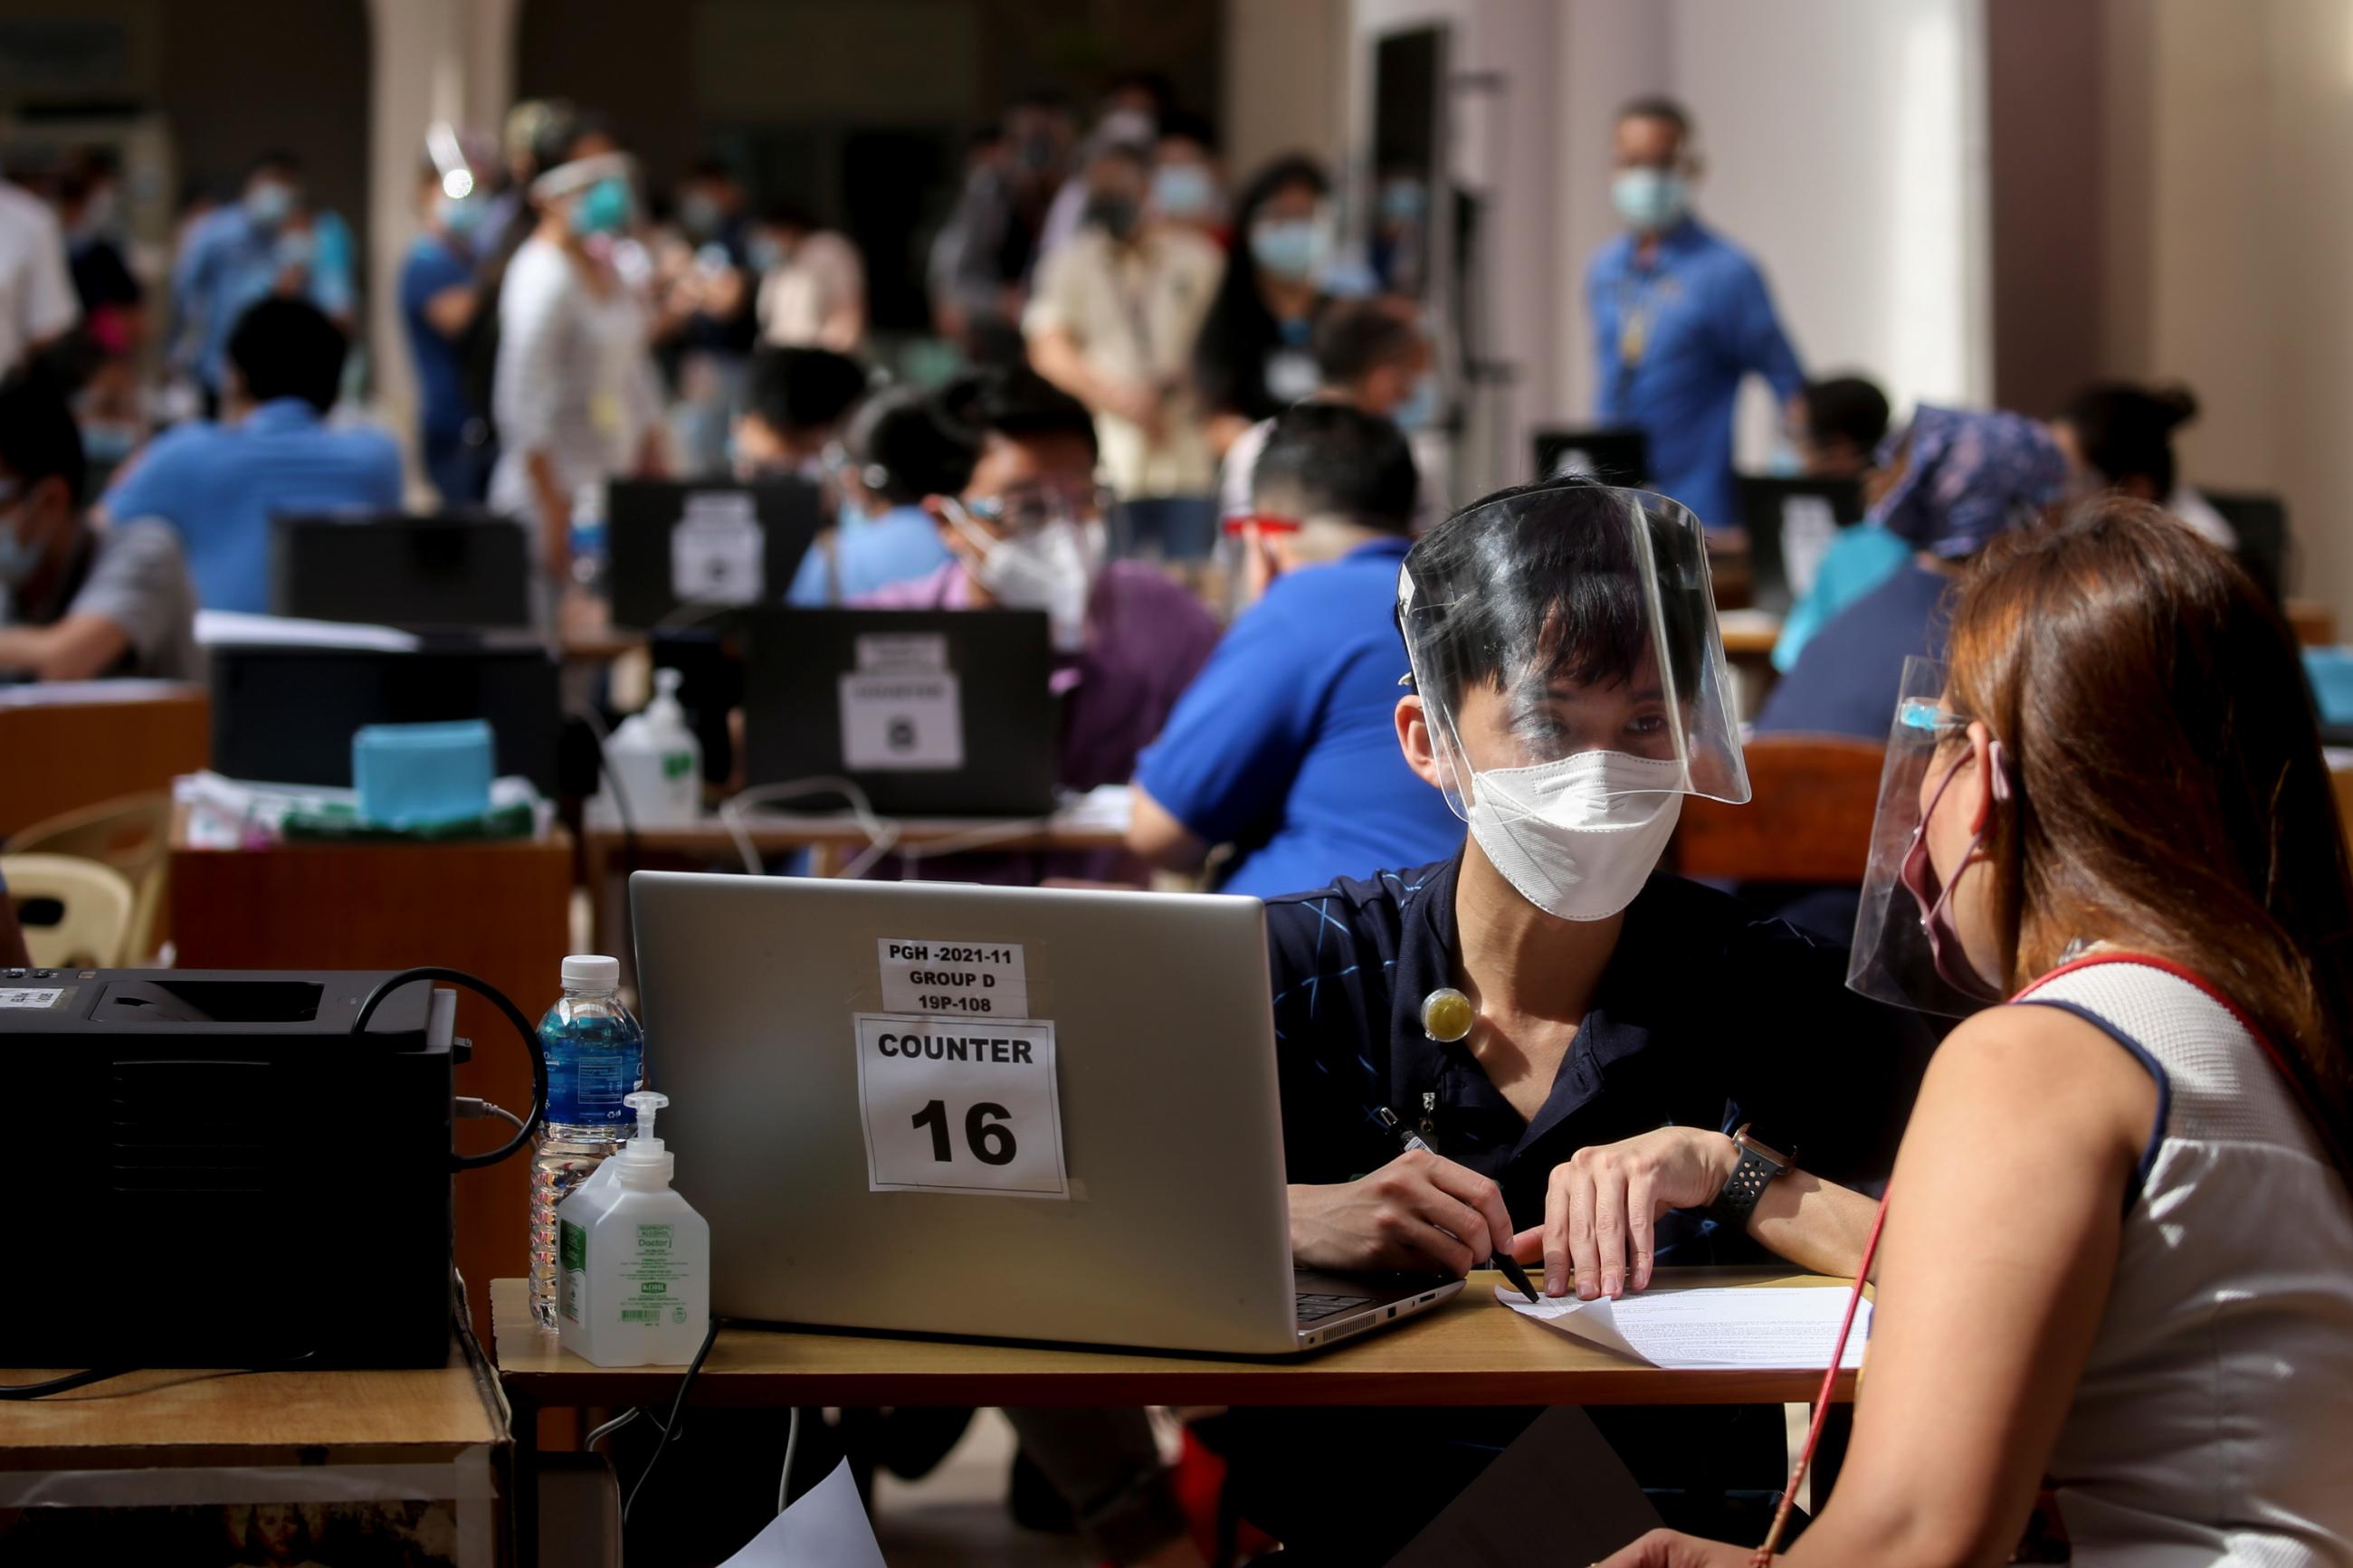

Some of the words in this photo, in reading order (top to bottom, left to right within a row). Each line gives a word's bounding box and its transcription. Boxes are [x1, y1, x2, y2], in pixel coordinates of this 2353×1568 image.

[890, 945, 929, 961] PGH
[934, 947, 1011, 965] -2021-11
[910, 971, 976, 987] GROUP
[983, 974, 996, 988] D
[919, 995, 992, 1012] 19P-108
[878, 1033, 1034, 1064] COUNTER
[911, 1099, 1017, 1166] 16
[638, 1239, 668, 1247] Doctor
